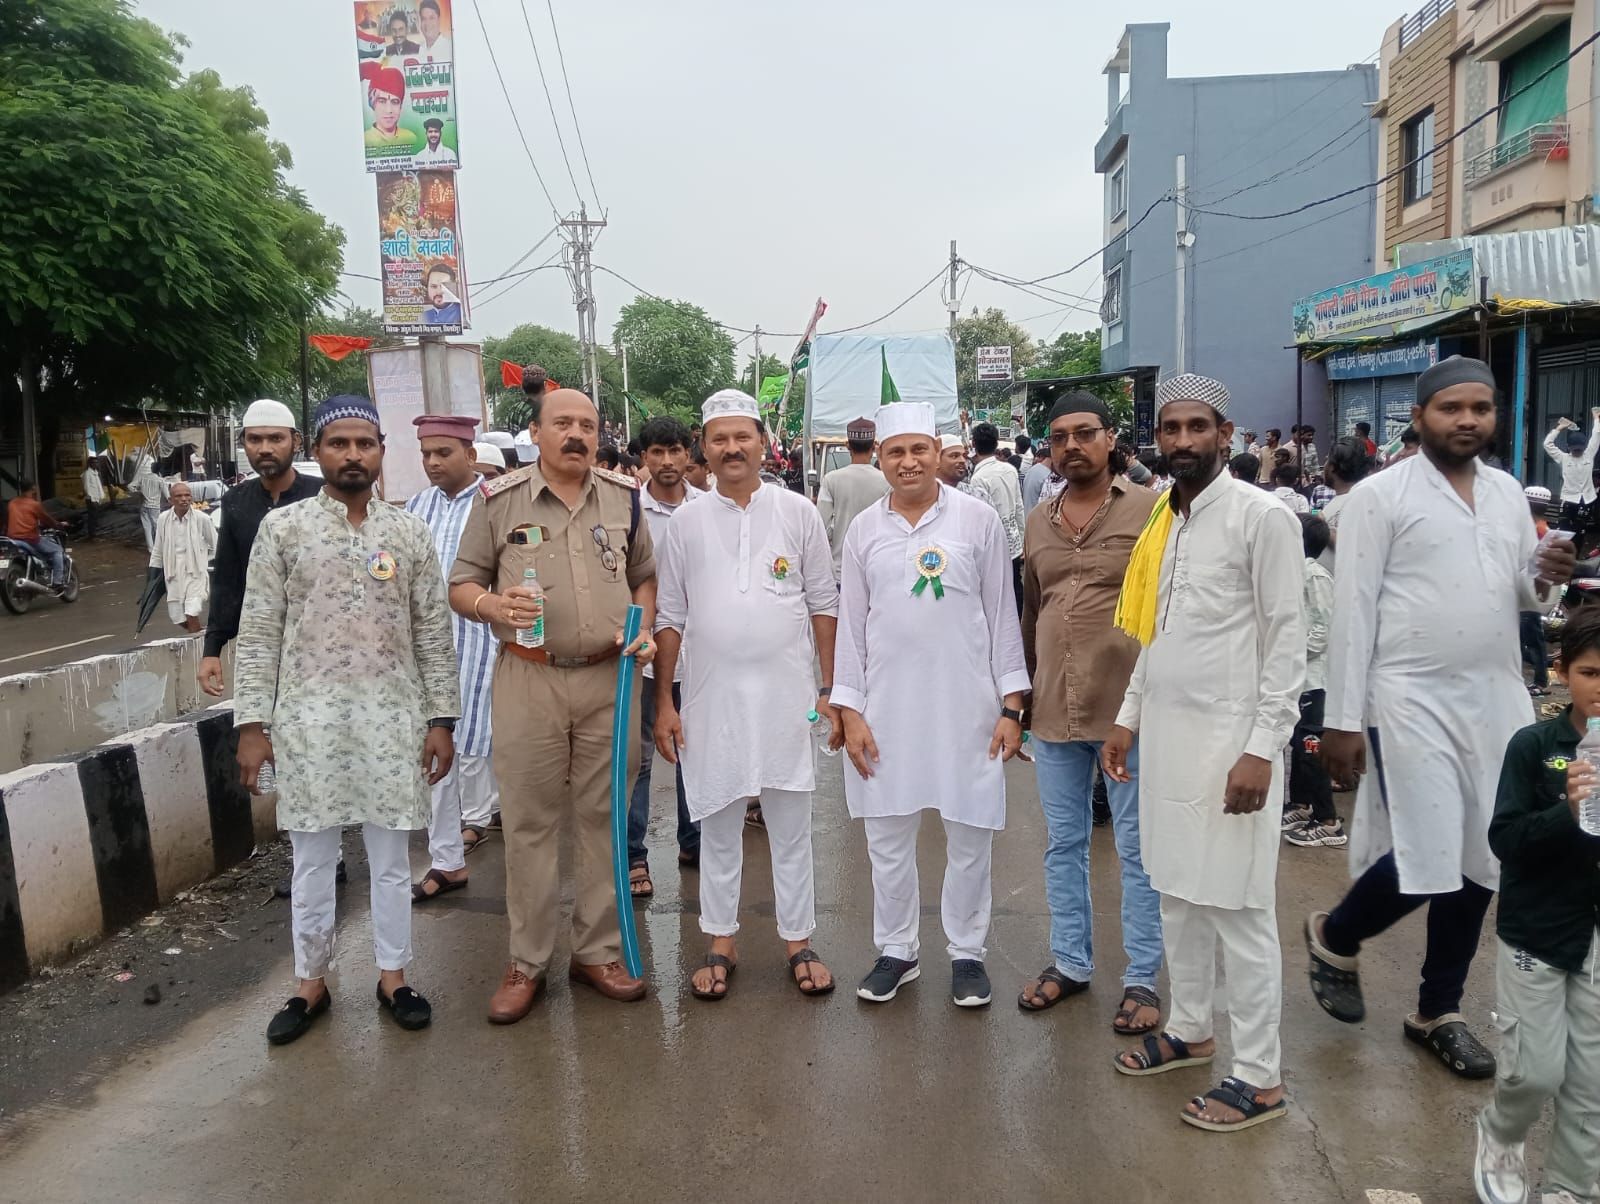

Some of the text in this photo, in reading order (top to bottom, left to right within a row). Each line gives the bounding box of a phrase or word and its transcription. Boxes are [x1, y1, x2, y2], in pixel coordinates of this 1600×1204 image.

[404, 55, 451, 87] तिरंगा
[410, 90, 449, 114] यात्रा
[381, 230, 410, 256] शाही
[417, 228, 454, 256] सवारी
[1340, 287, 1358, 314] ऑटो
[1381, 289, 1388, 305] &
[1390, 272, 1410, 303] ऑटो
